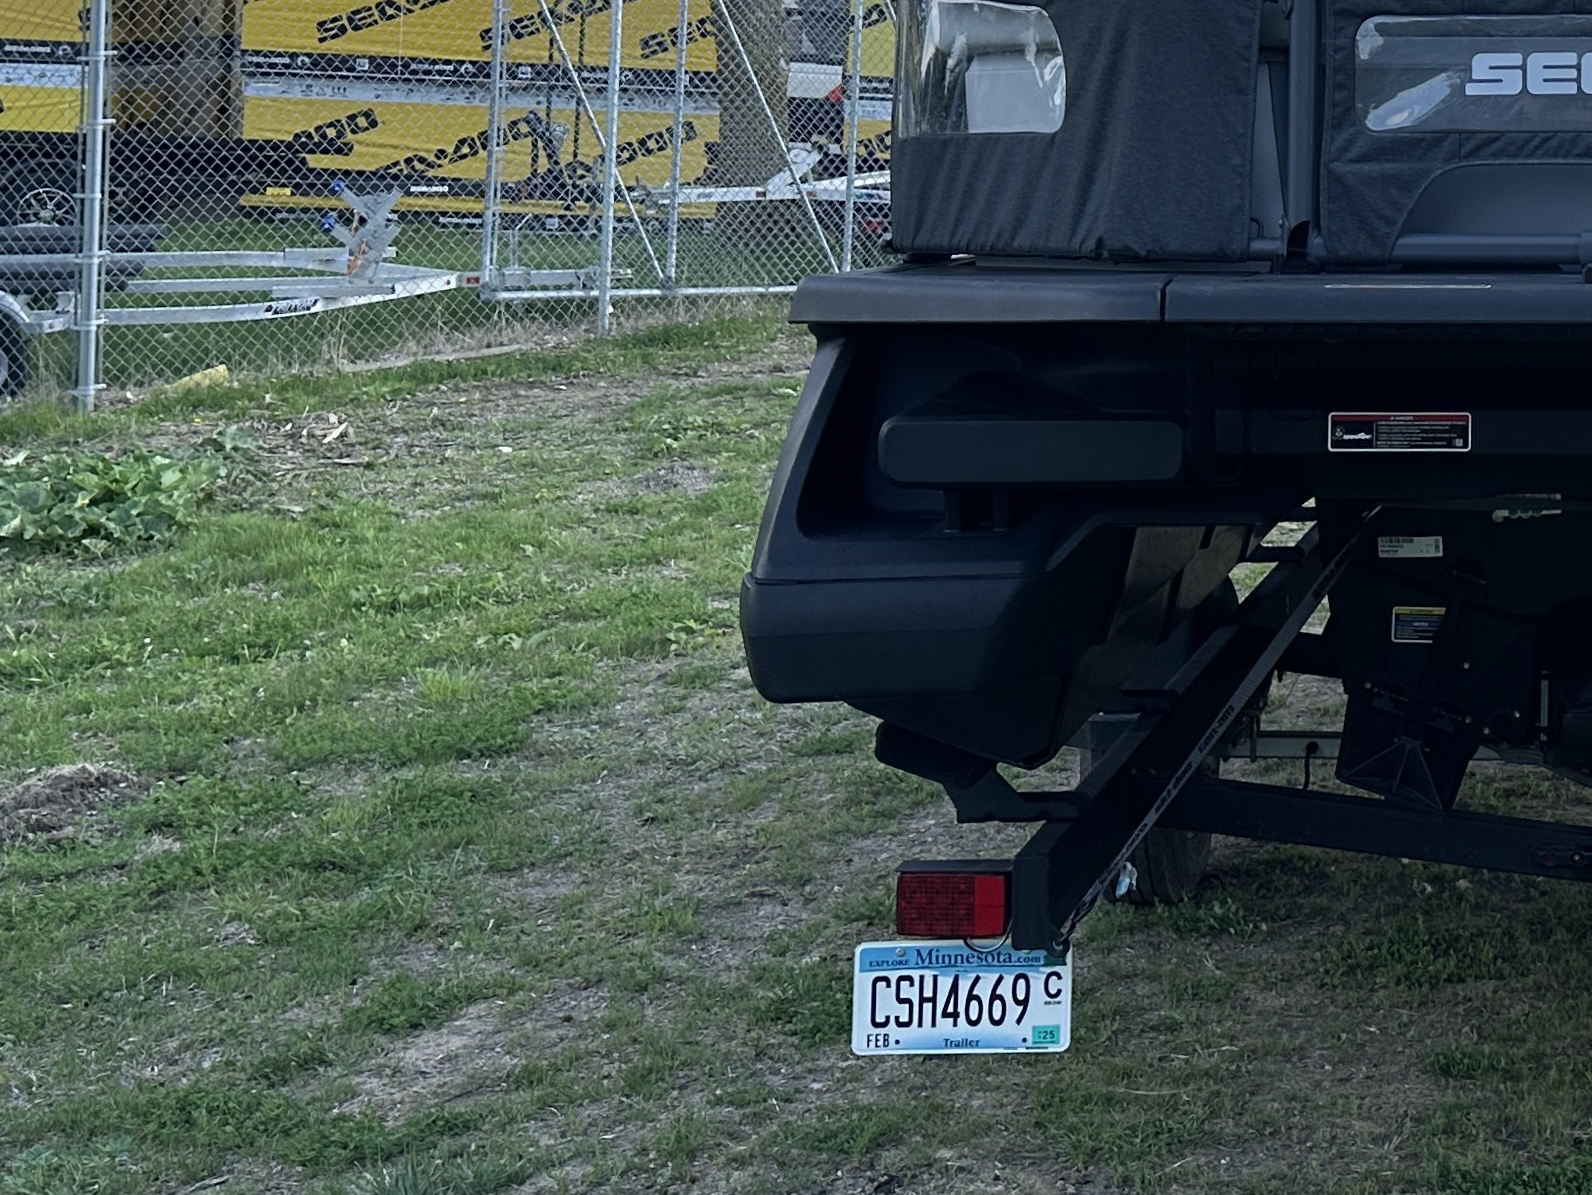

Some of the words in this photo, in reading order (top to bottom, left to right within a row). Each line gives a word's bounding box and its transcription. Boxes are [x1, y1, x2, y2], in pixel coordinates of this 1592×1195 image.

[870, 972, 1031, 1029] CSH4669
[1043, 971, 1064, 999] C
[867, 1033, 890, 1048] FEB
[1042, 1030, 1055, 1040] 25
[943, 1037, 981, 1048] Trailer
